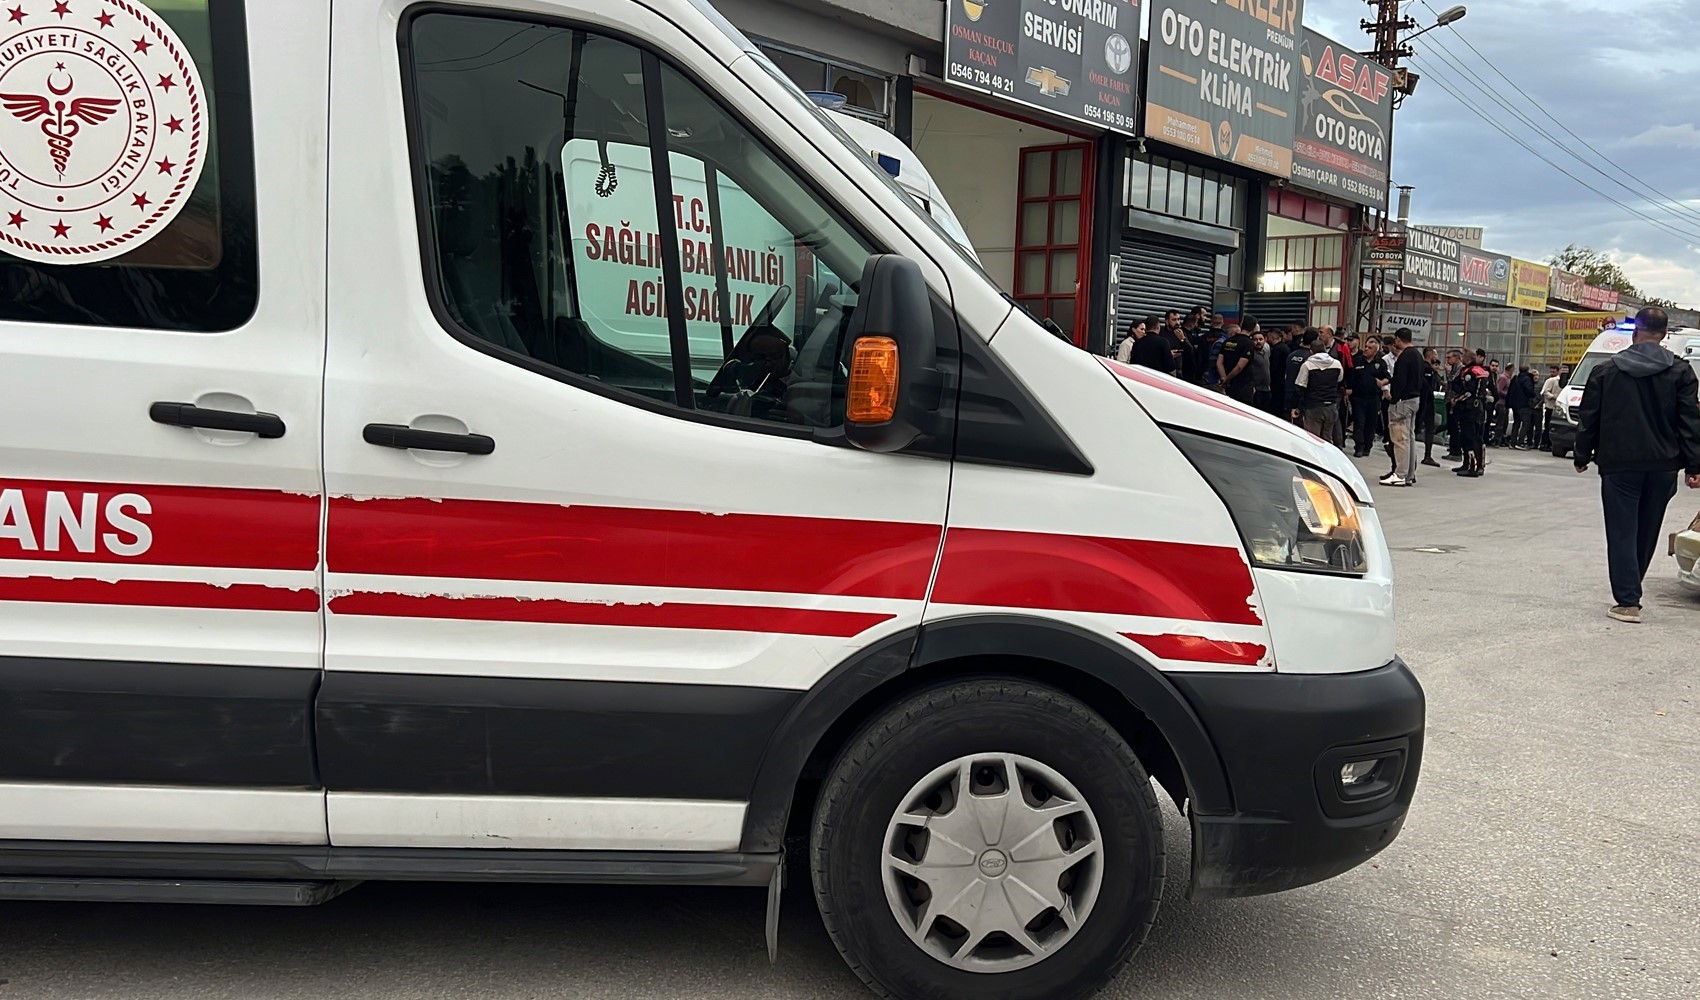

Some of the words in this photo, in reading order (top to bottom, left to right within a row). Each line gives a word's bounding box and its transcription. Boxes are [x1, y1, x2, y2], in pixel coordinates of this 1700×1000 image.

[0, 33, 77, 67] URİYETİ
[952, 24, 982, 43] OSMAN
[983, 34, 1014, 56] SELÇUK
[1024, 11, 1082, 55] SERVİSİ
[1161, 8, 1204, 57] OTO
[1208, 28, 1291, 93] ELEKTRİK
[84, 40, 140, 94] SAĞLIK
[951, 62, 973, 80] 0546
[974, 69, 990, 86] 794
[991, 74, 1003, 89] 48
[1003, 78, 1014, 93] 21
[1315, 45, 1390, 105] ASAF
[1200, 68, 1252, 117] KLİMA
[1084, 103, 1101, 119] 0554
[1102, 109, 1115, 123] 196
[1116, 113, 1125, 126] 50
[1125, 116, 1134, 129] 59
[102, 98, 149, 193] BAKANLIĞI
[1315, 113, 1346, 146] OTO
[1348, 125, 1383, 161] BOYA
[0, 162, 19, 190] TÜ
[1292, 162, 1315, 179] Osman
[1316, 168, 1338, 187] ÇAPAR
[1341, 177, 1347, 189] 0
[1347, 179, 1358, 193] 552
[673, 195, 711, 234] T.C.
[1372, 238, 1404, 247] ASAF
[1385, 252, 1403, 260] BOYA
[1408, 230, 1440, 253] YILMAZ
[1441, 240, 1457, 258] OTO
[1405, 254, 1436, 279] KAPORTA
[1436, 261, 1442, 280] &
[1442, 262, 1458, 283] BOYA
[685, 286, 754, 326] SAIK
[1107, 261, 1119, 358] KLİ
[1386, 315, 1429, 328] ALTUNAY
[0, 488, 153, 556] ANS
